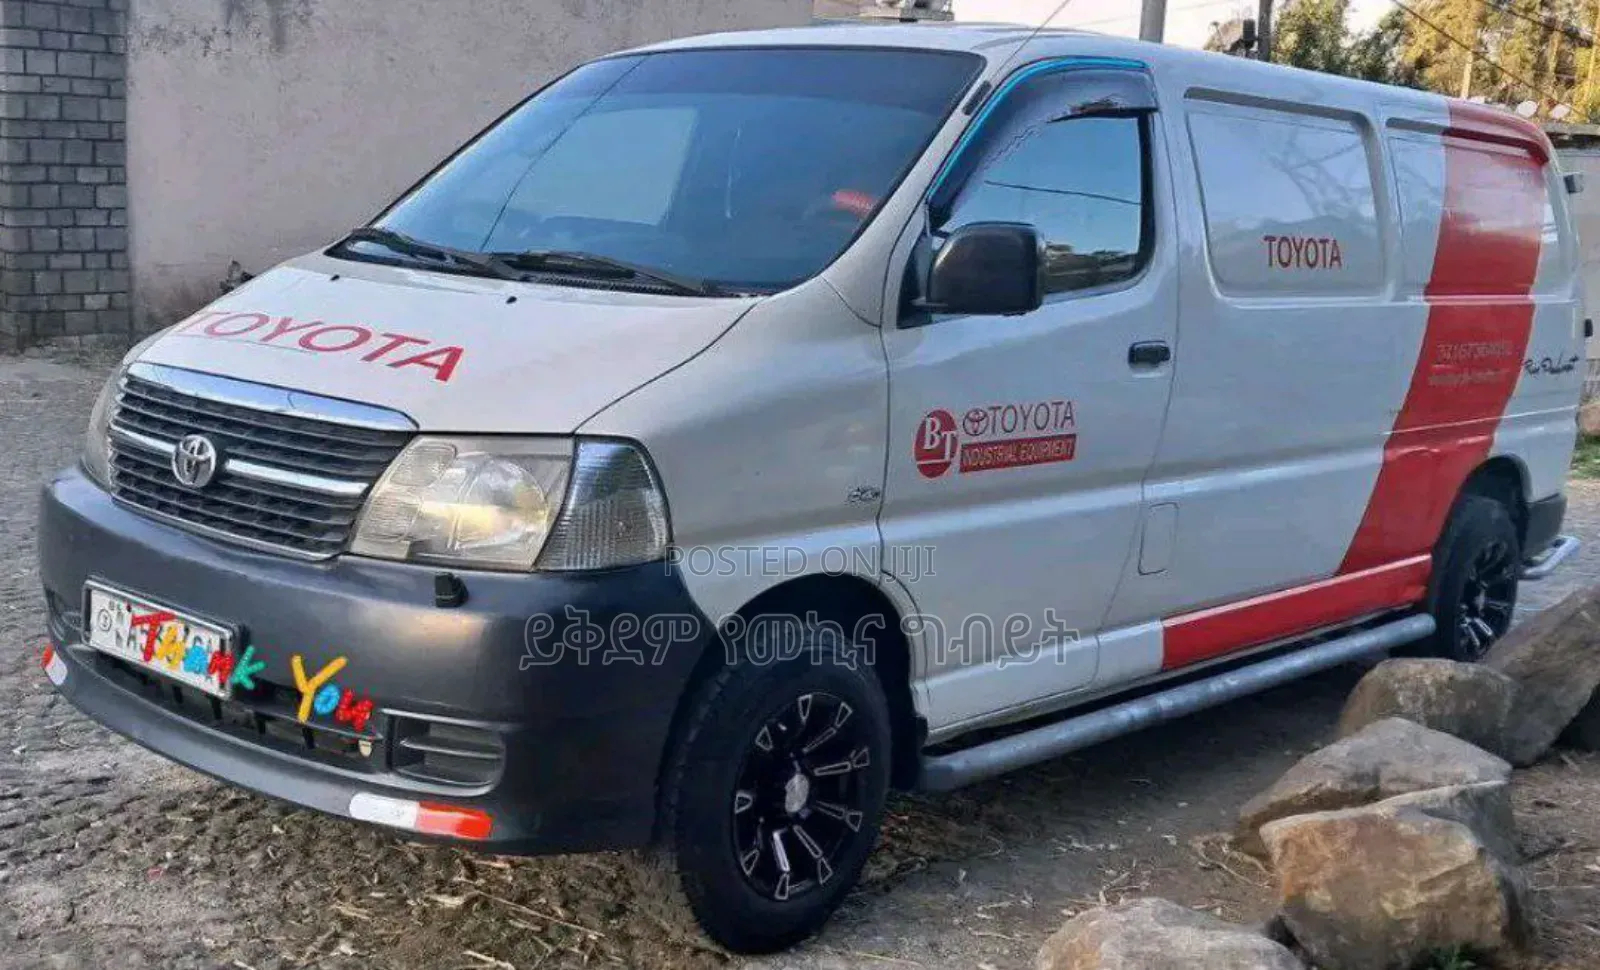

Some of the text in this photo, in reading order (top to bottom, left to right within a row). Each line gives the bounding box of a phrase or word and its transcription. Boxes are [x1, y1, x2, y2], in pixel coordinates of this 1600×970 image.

[1263, 235, 1342, 269] TOYOTA
[178, 312, 465, 383] TOYOTA
[988, 400, 1075, 434] TOYOTA
[922, 416, 957, 462] BT
